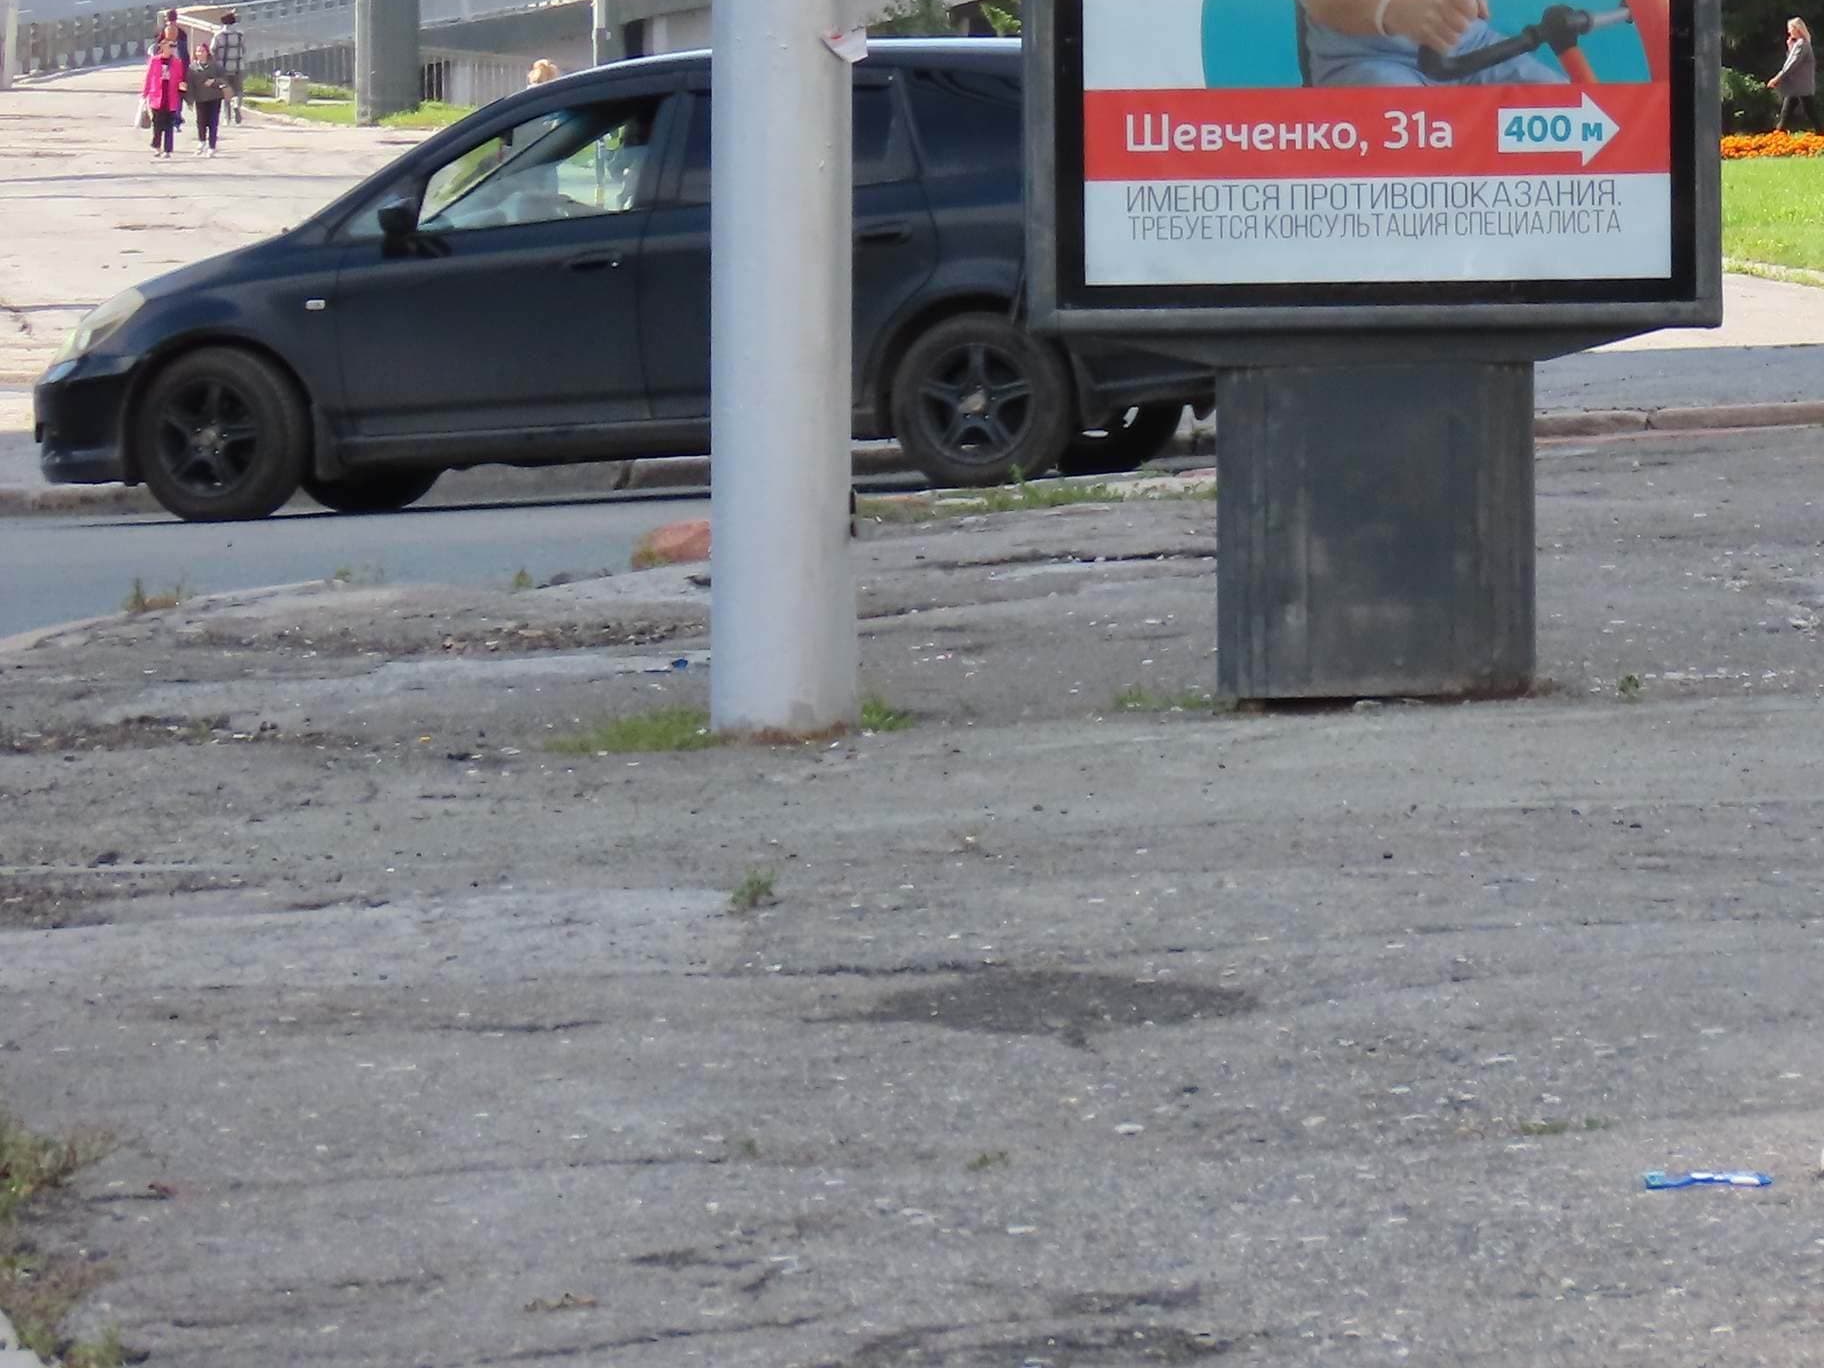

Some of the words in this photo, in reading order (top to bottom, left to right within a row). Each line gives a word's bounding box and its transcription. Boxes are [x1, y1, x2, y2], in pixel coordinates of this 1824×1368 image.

[1125, 112, 1368, 157] Шевченко,
[1382, 110, 1454, 151] 31а
[1503, 114, 1572, 143] 400
[1580, 120, 1604, 142] м
[1126, 183, 1281, 214] ИМЕЮТСЯ
[1290, 178, 1623, 212] ПРОТИВОПОКАЗАНИЯ.
[1128, 213, 1260, 241] ТРЕБУЕТСЯ
[1264, 211, 1449, 241] КОНСУЛЬТАЦИЯ
[1454, 208, 1622, 238] СПЕЦИАЛИСТА
